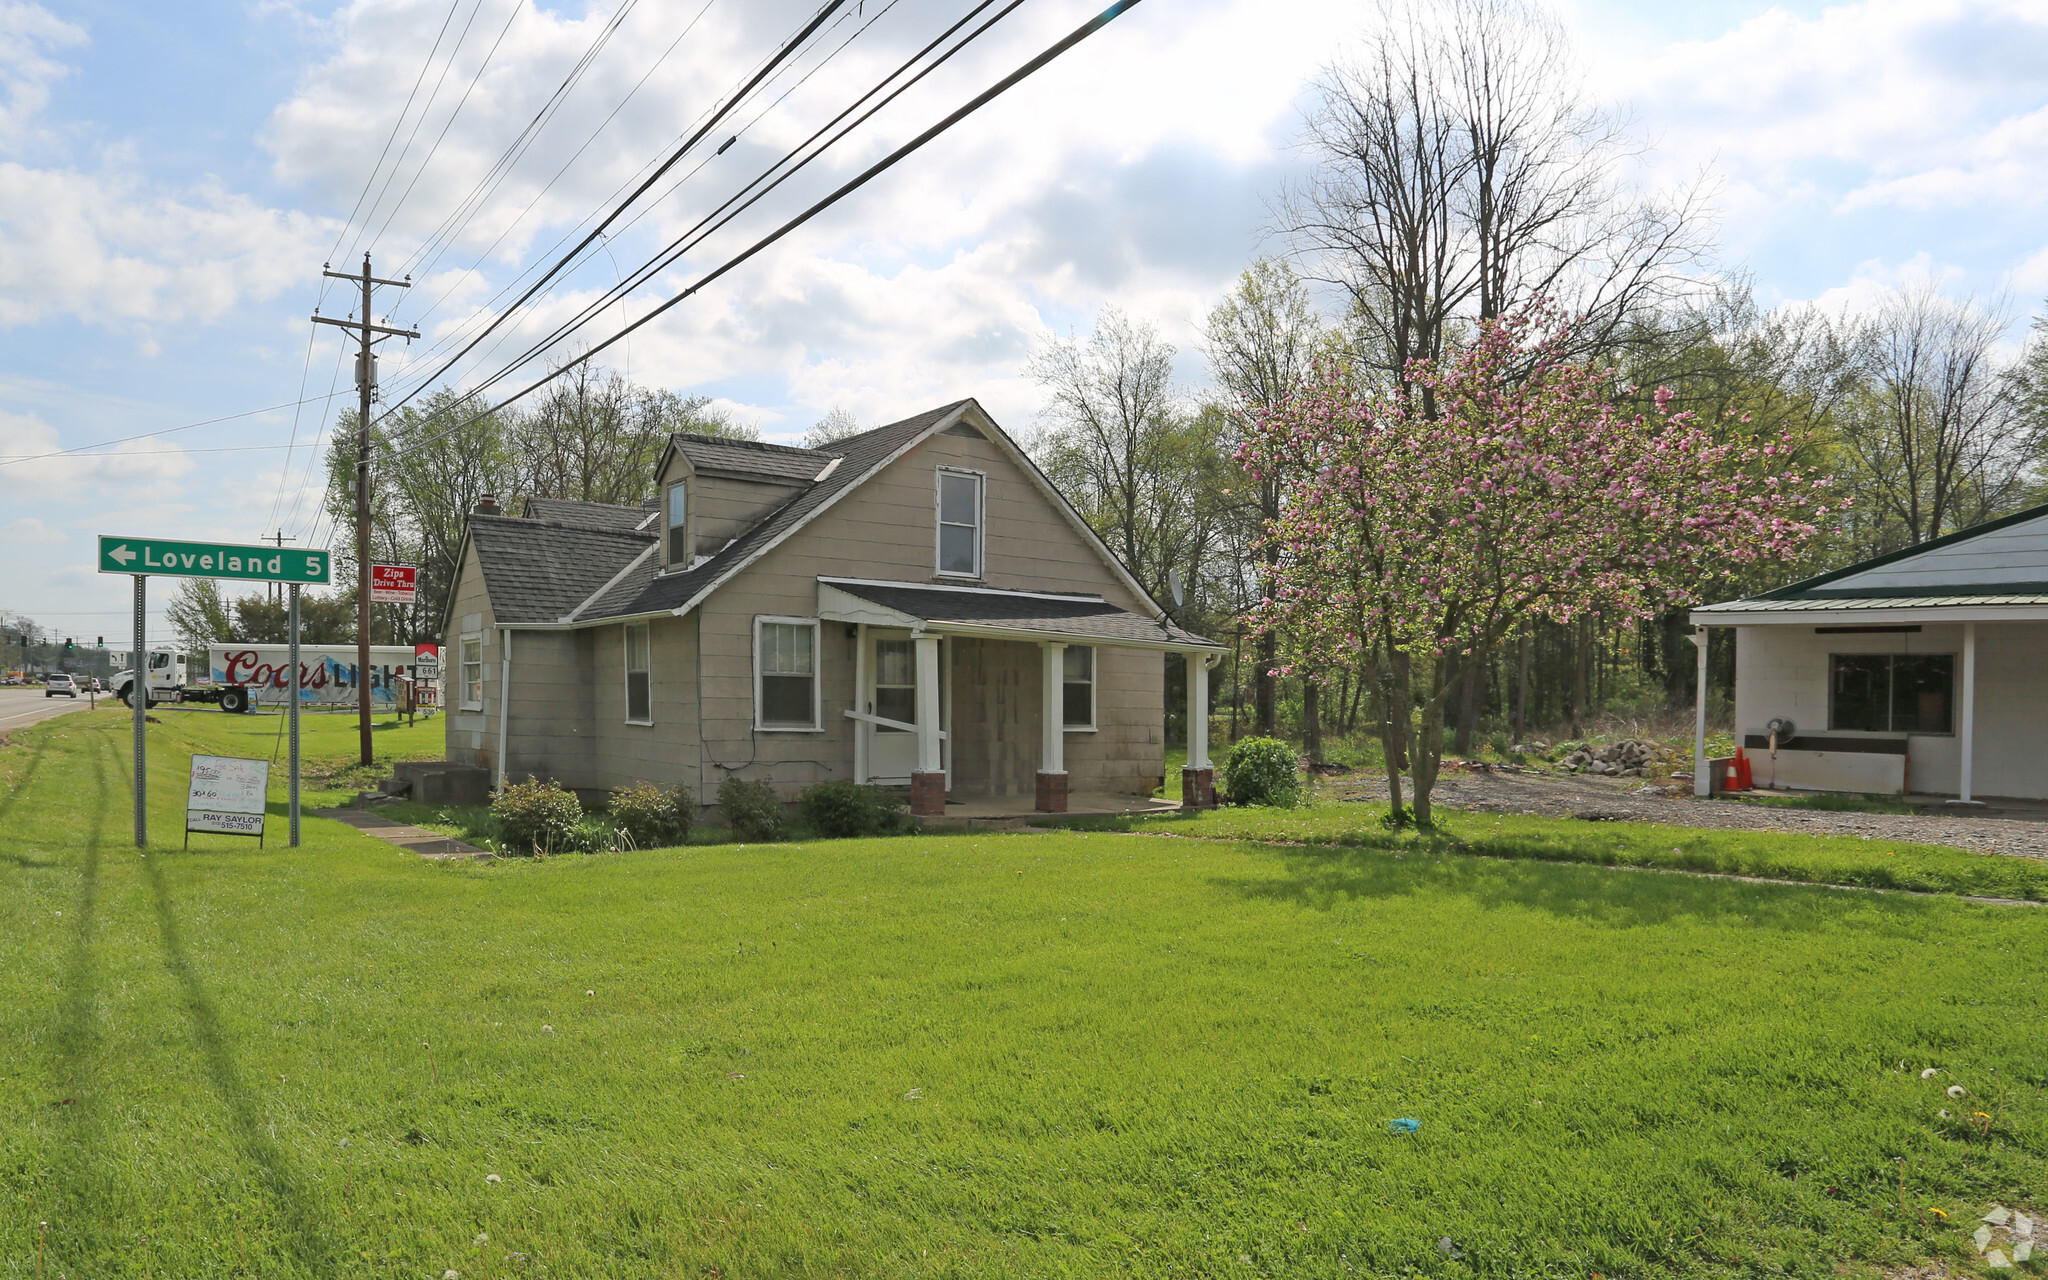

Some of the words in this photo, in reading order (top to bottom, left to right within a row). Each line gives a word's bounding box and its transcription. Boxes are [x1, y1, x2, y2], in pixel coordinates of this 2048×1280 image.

[145, 546, 281, 574] Loveland
[305, 556, 322, 577] 5
[383, 568, 404, 579] Zips
[417, 655, 436, 663] Marlboro
[203, 813, 222, 821] RAY
[225, 815, 262, 824] SAYLOR
[221, 822, 253, 830] 515-7510
